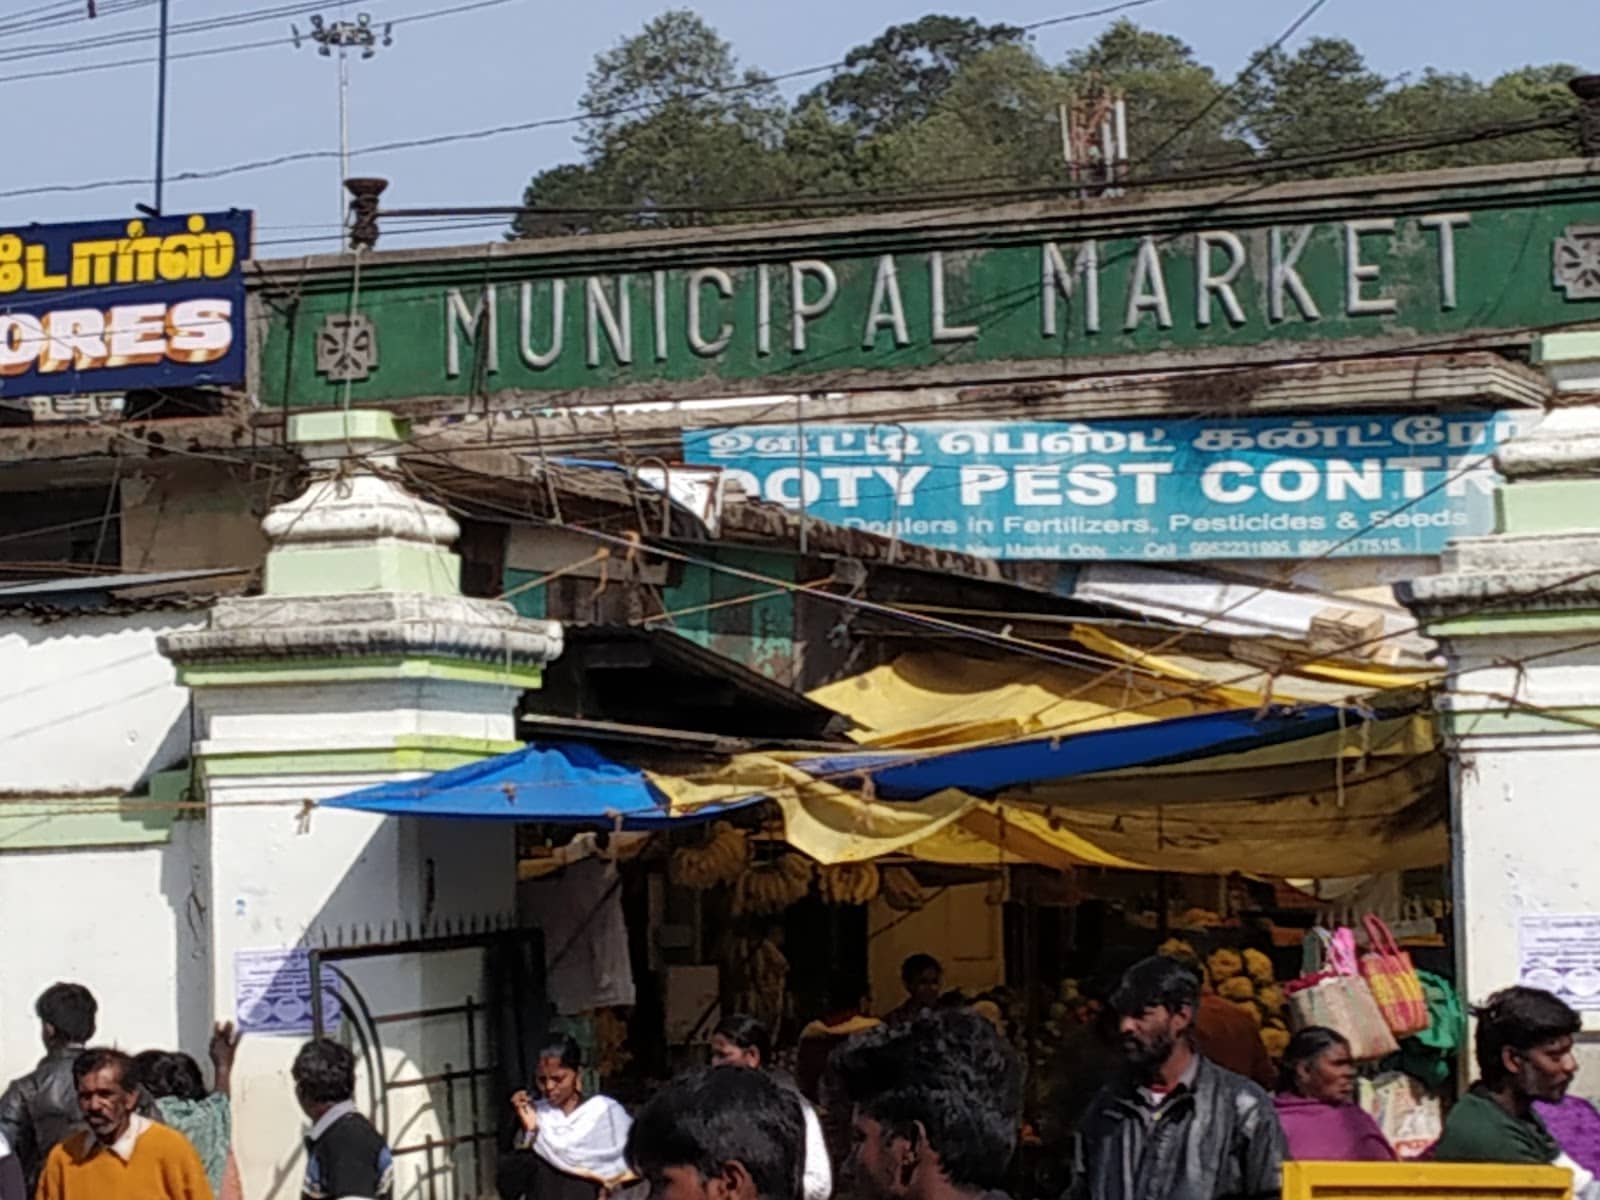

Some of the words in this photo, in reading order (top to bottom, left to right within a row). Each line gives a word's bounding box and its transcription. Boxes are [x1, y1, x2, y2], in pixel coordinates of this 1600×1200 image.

[446, 252, 980, 377] MUNICIPAL
[1040, 212, 1470, 337] MARKET
[938, 422, 1177, 453] பெஸ்ட்
[959, 462, 1174, 507] PEST
[1200, 454, 1496, 505] CONTR
[842, 516, 958, 536] Dealers
[967, 516, 993, 535] in
[1168, 512, 1327, 532] Pesticides
[1336, 511, 1359, 531] &
[1369, 508, 1469, 529] Seeds
